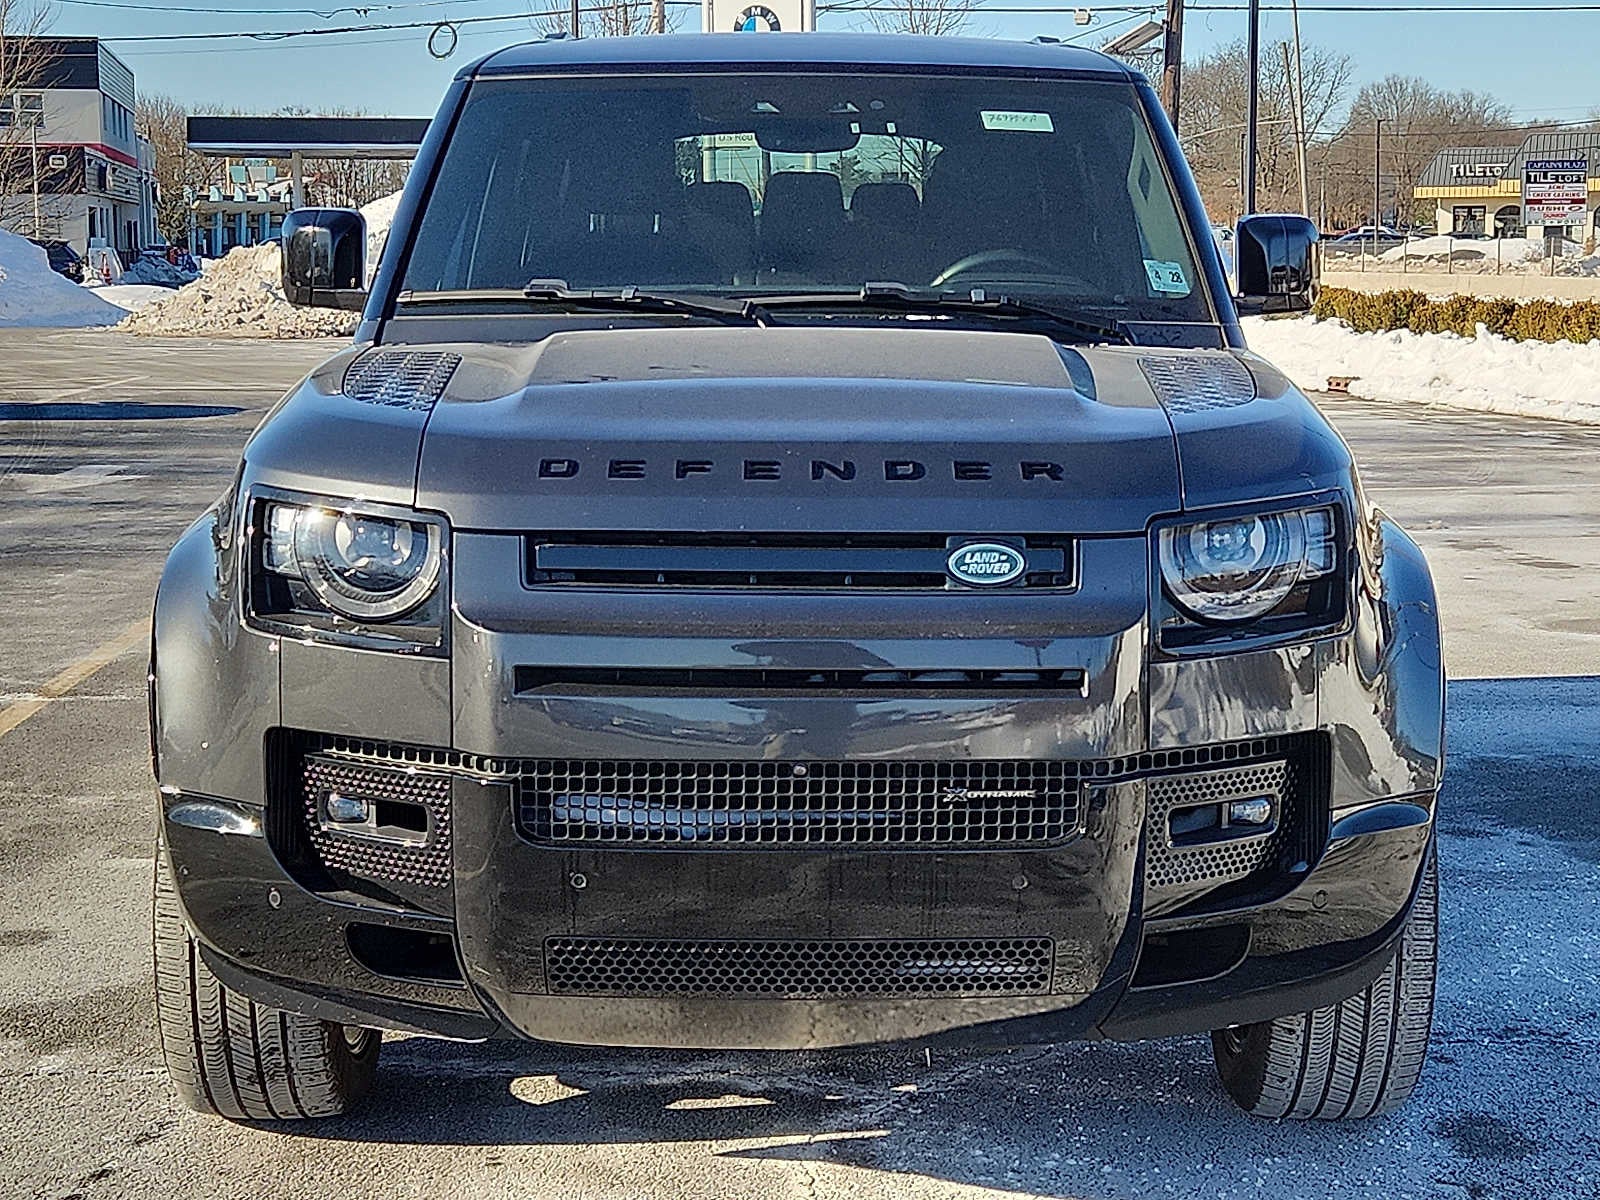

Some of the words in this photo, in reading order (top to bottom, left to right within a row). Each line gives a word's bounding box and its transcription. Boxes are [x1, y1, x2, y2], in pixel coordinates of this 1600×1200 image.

[736, 6, 777, 25] BMW
[1450, 163, 1484, 177] TILE
[1563, 161, 1586, 169] PLAZA
[1528, 171, 1557, 183] TILE
[1558, 175, 1585, 183] LOFT
[1169, 271, 1183, 284] 28
[538, 458, 1065, 482] DEFENDER
[967, 789, 1038, 799] DYNAMIC
